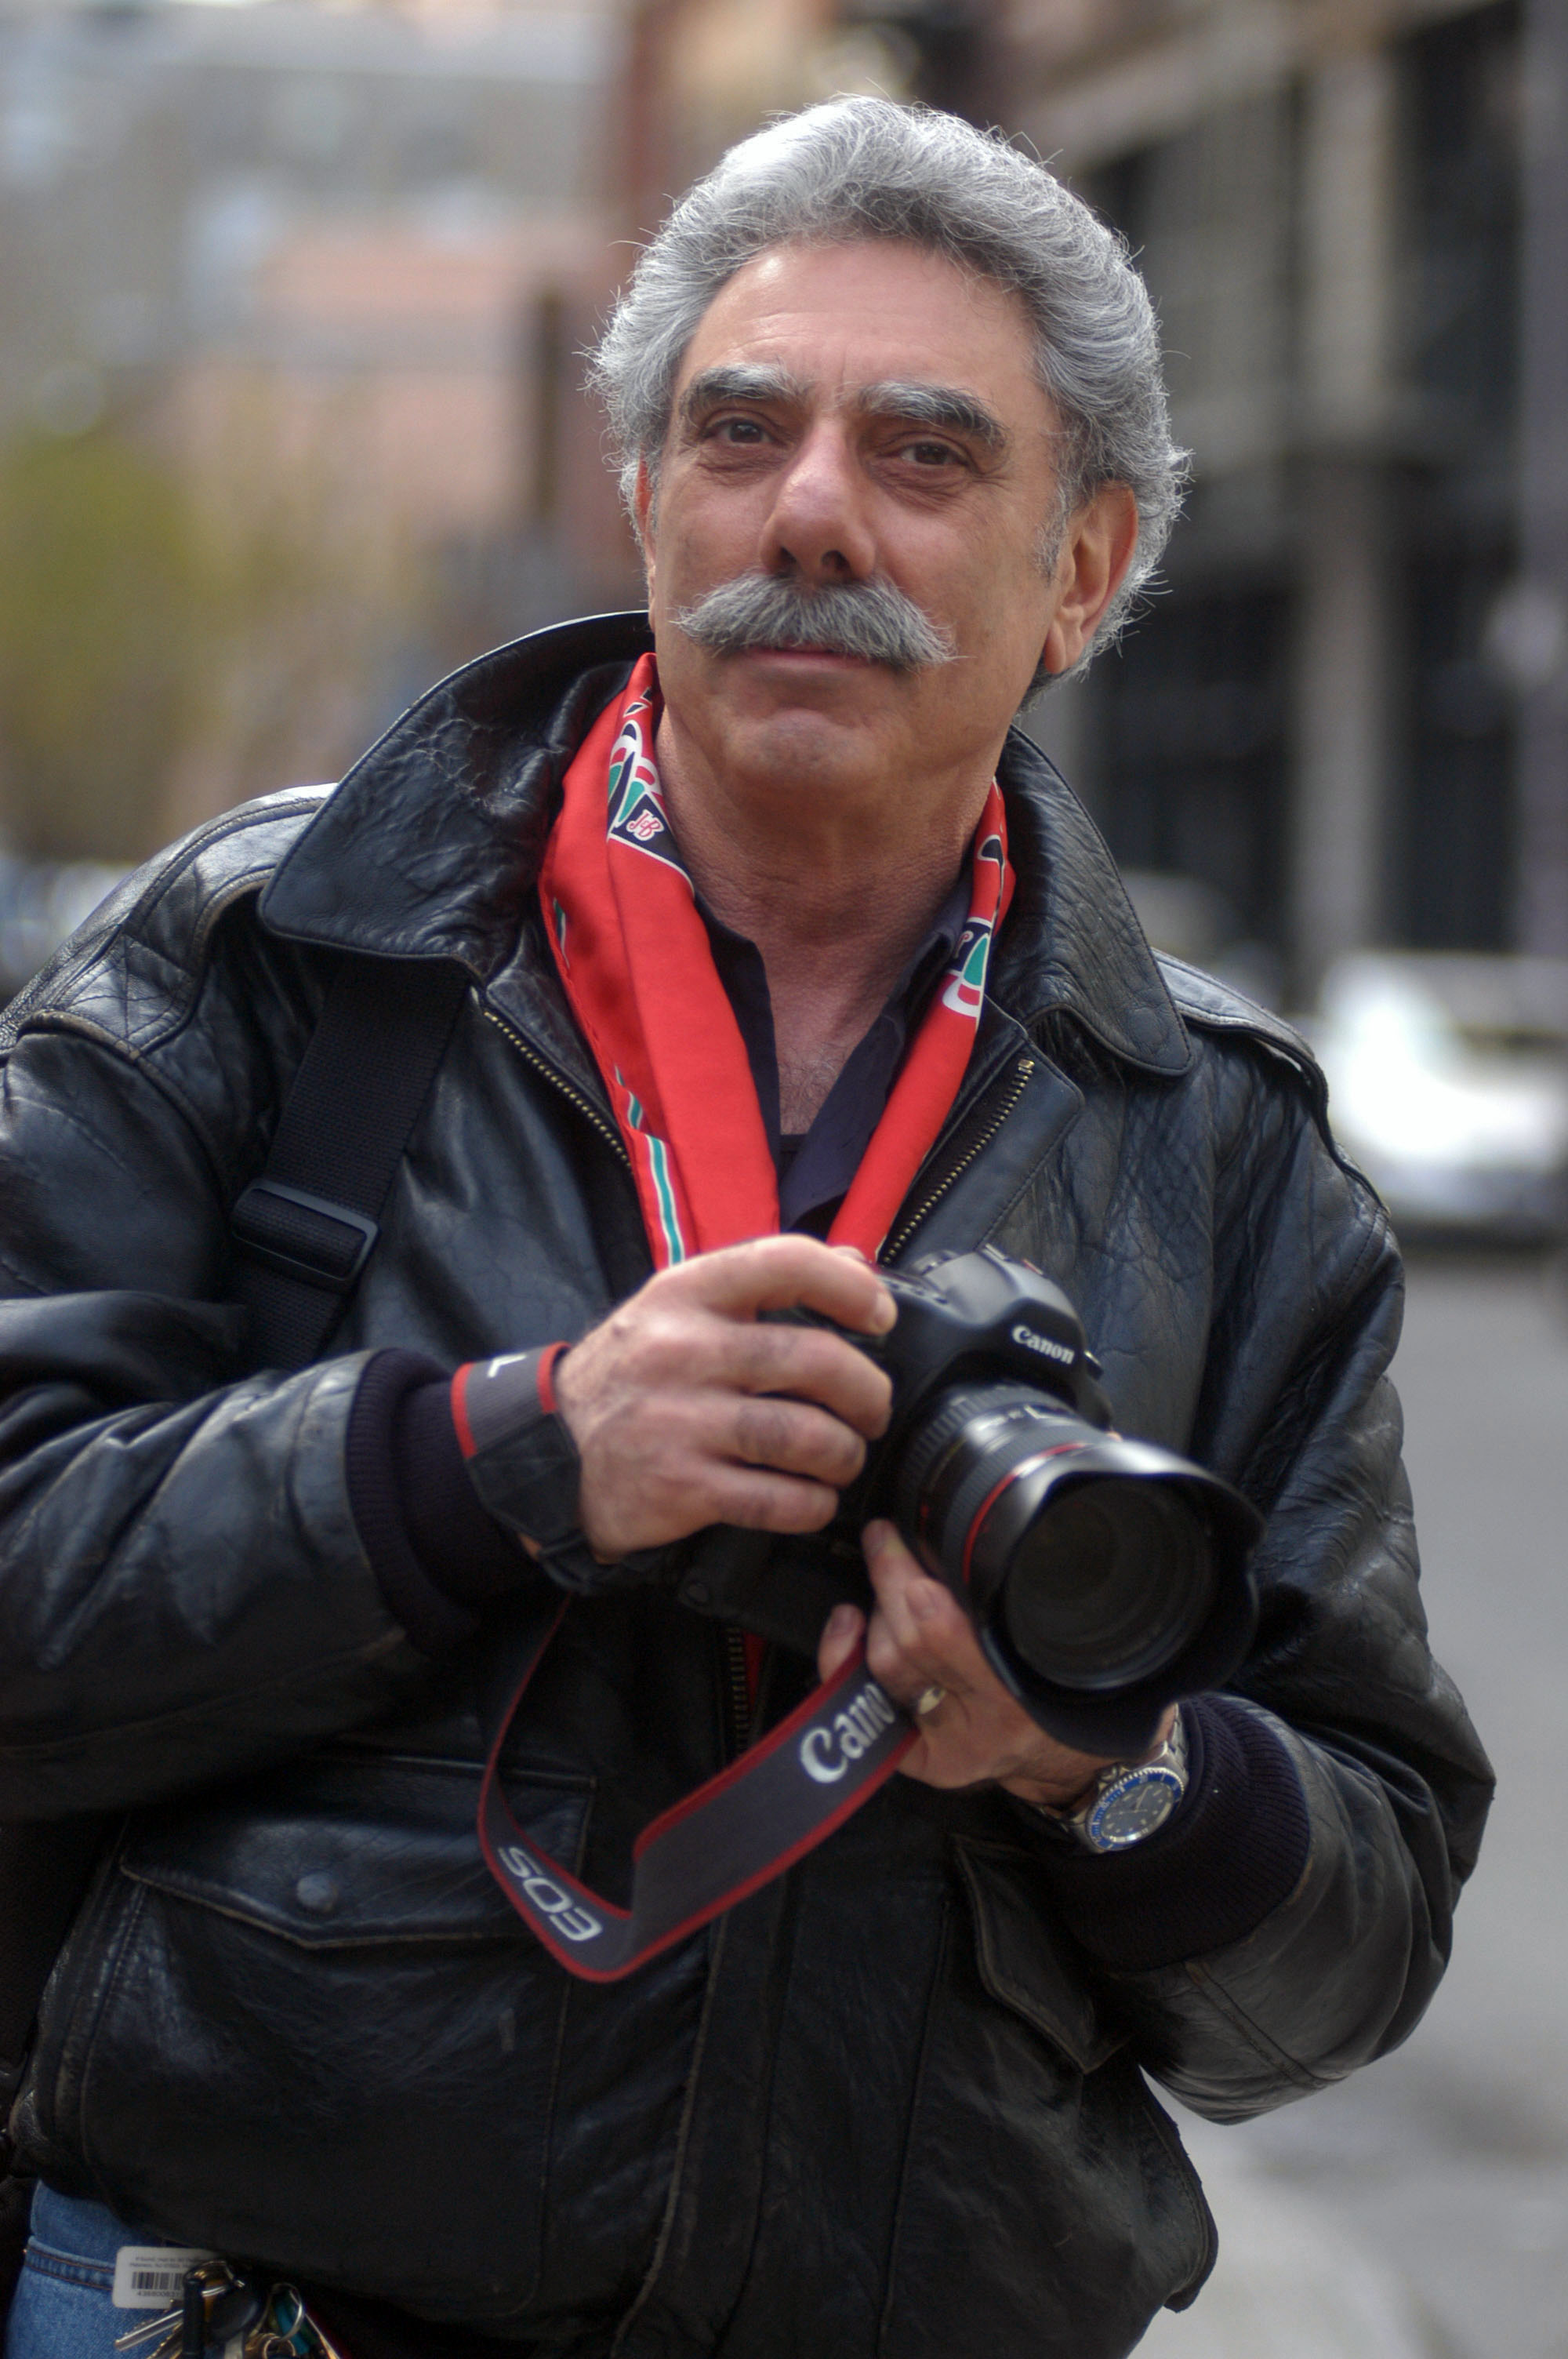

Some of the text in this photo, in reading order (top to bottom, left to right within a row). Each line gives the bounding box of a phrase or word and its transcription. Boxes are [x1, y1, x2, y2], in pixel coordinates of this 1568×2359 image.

[1012, 1325, 1075, 1365] Canon
[800, 1683, 895, 1784] Cano
[498, 1847, 603, 1941] EOS
